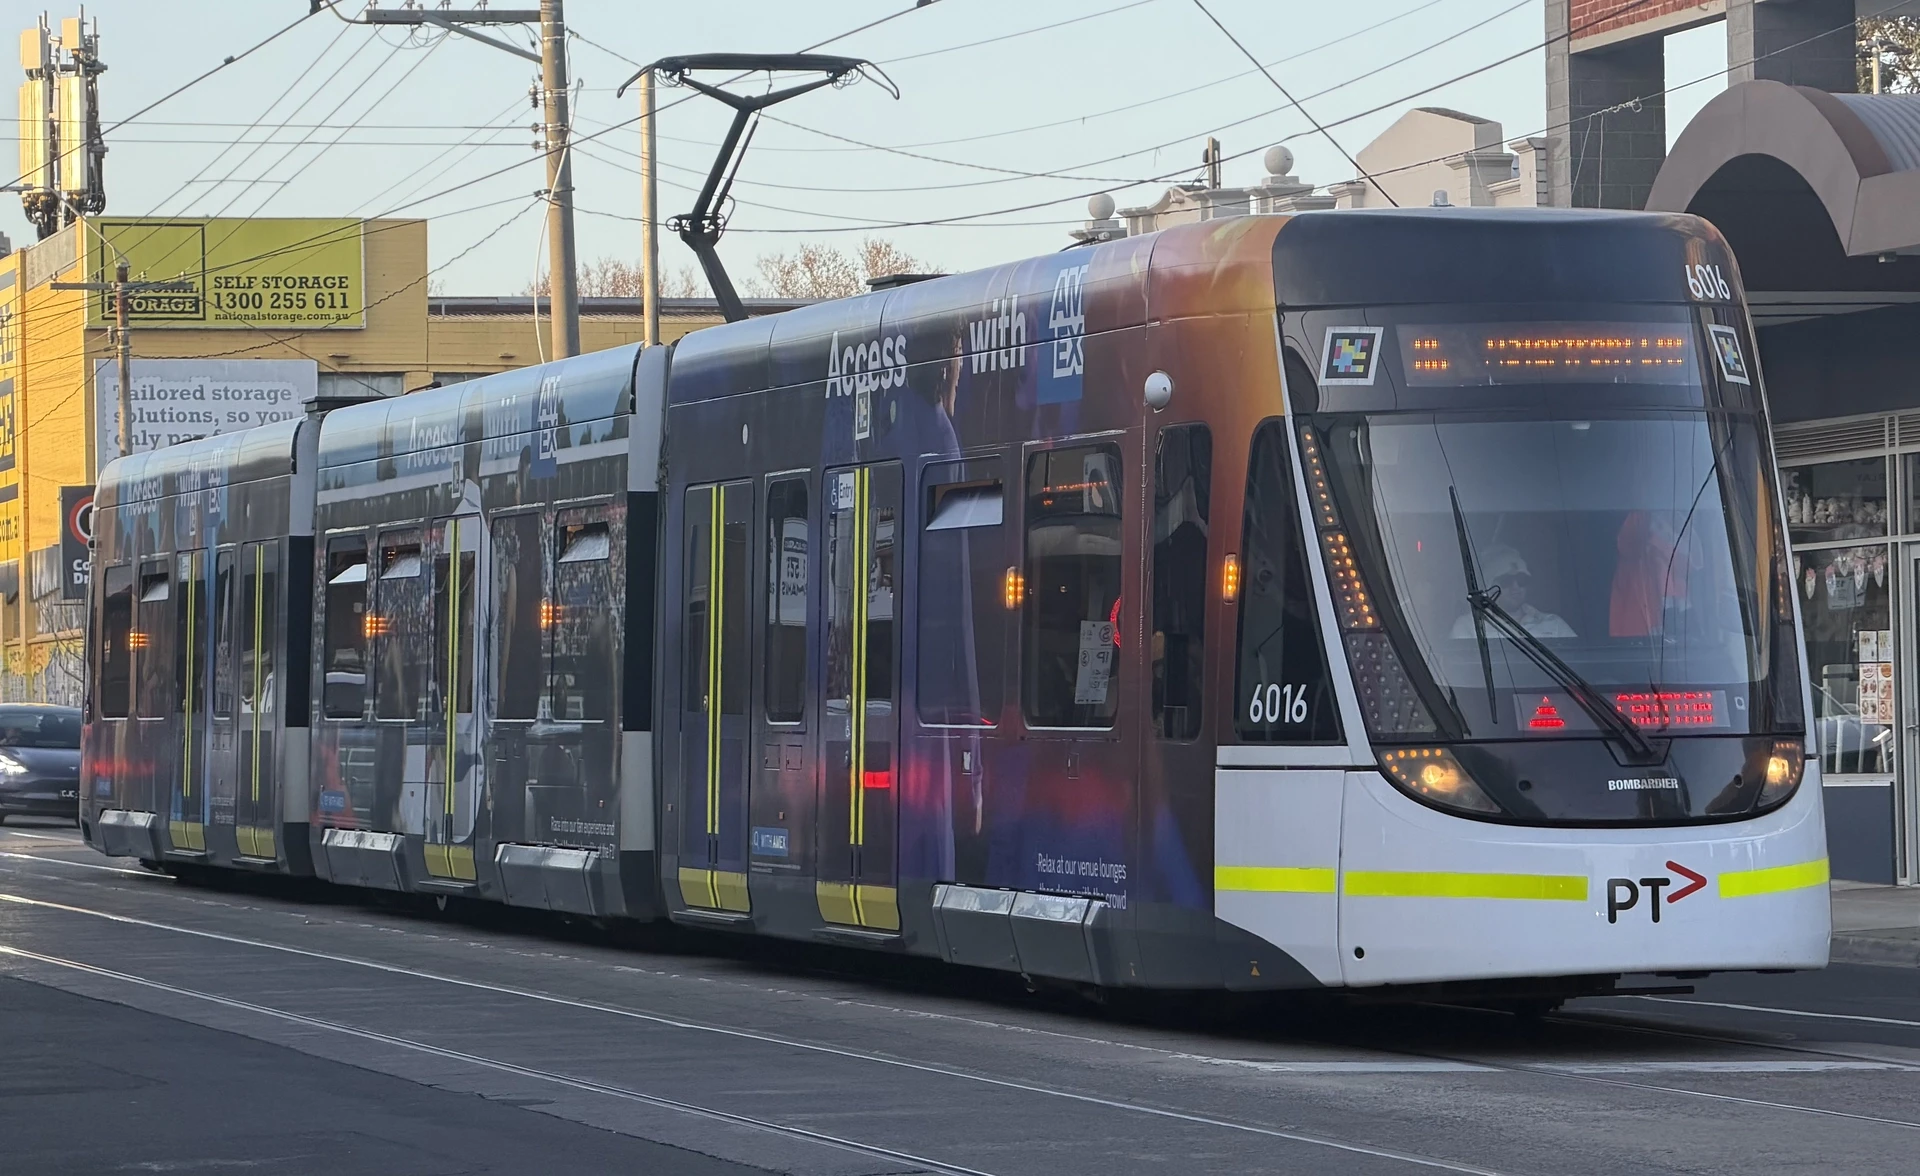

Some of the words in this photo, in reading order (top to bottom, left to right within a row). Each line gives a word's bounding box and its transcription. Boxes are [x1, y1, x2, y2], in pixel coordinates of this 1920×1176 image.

[214, 276, 257, 289] SELF
[262, 276, 349, 289] STORAGE
[1685, 264, 1731, 300] 6016
[214, 292, 263, 309] 1300
[270, 292, 307, 309] 255
[314, 292, 349, 309] 611
[215, 311, 349, 323] nationalstorage.com.au
[825, 330, 908, 399] Access
[970, 293, 1026, 374] with
[212, 386, 291, 405] storage
[227, 410, 250, 424] so
[407, 416, 459, 469] Access
[488, 394, 520, 455] with
[1249, 683, 1308, 723] 6016
[1608, 778, 1679, 791] BOMBARDIER
[1037, 853, 1056, 873] Relax
[1056, 855, 1064, 874] at
[1064, 859, 1077, 875] our
[1077, 860, 1099, 877] venue
[1099, 856, 1127, 884] lounges
[1105, 889, 1127, 910] crowd
